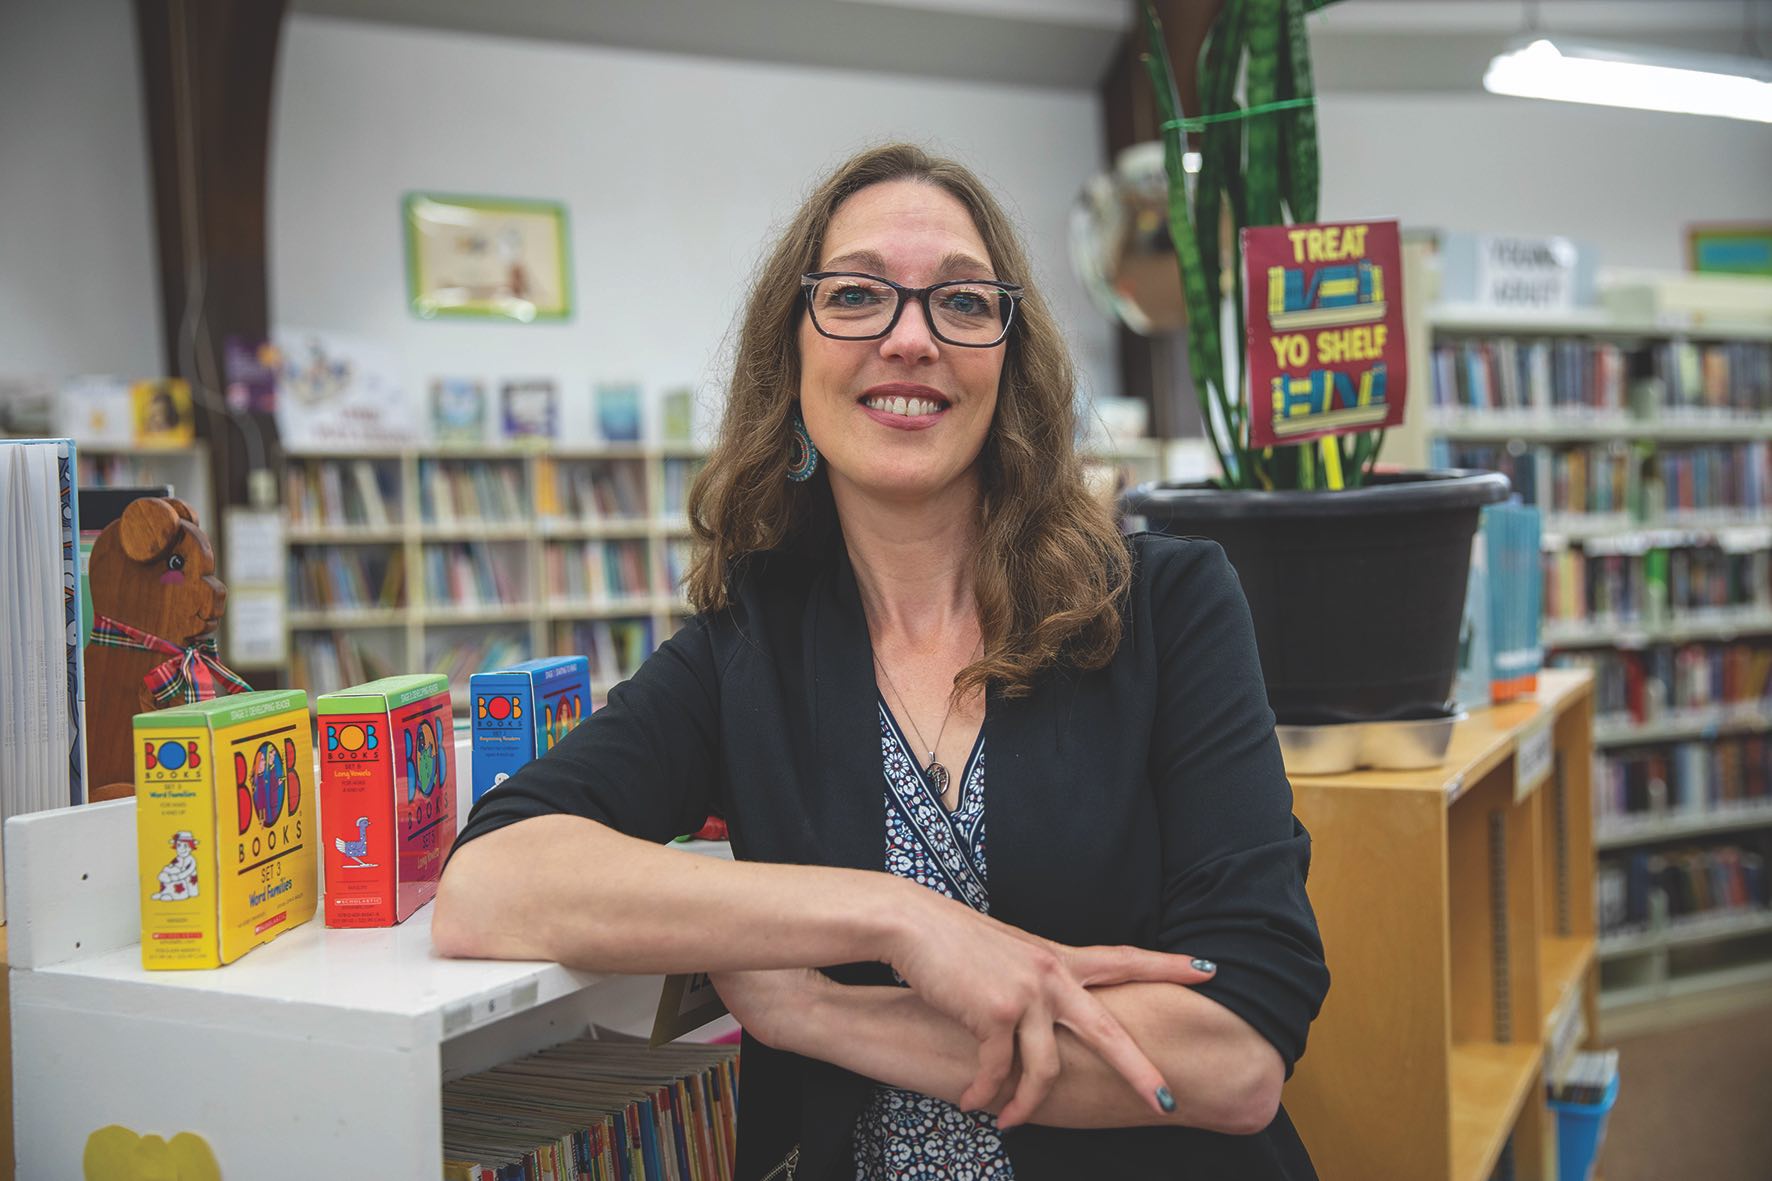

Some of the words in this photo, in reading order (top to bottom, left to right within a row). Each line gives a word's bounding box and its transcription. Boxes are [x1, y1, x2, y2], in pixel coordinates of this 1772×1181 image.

[1288, 224, 1369, 263] TREAT
[1270, 333, 1310, 369] YO
[1316, 323, 1388, 364] SHELF
[478, 696, 523, 720] BOB
[327, 724, 379, 752] BOB
[145, 740, 201, 770] BOB
[404, 716, 447, 804] BOB
[145, 771, 201, 779] BOOKS
[234, 737, 301, 836] BOB
[334, 769, 350, 779] Long
[408, 791, 448, 830] BOOKS
[239, 820, 302, 864] BOOKS
[261, 864, 274, 883] SET
[276, 861, 282, 877] 3
[249, 885, 267, 908] Word
[267, 877, 293, 900] Families
